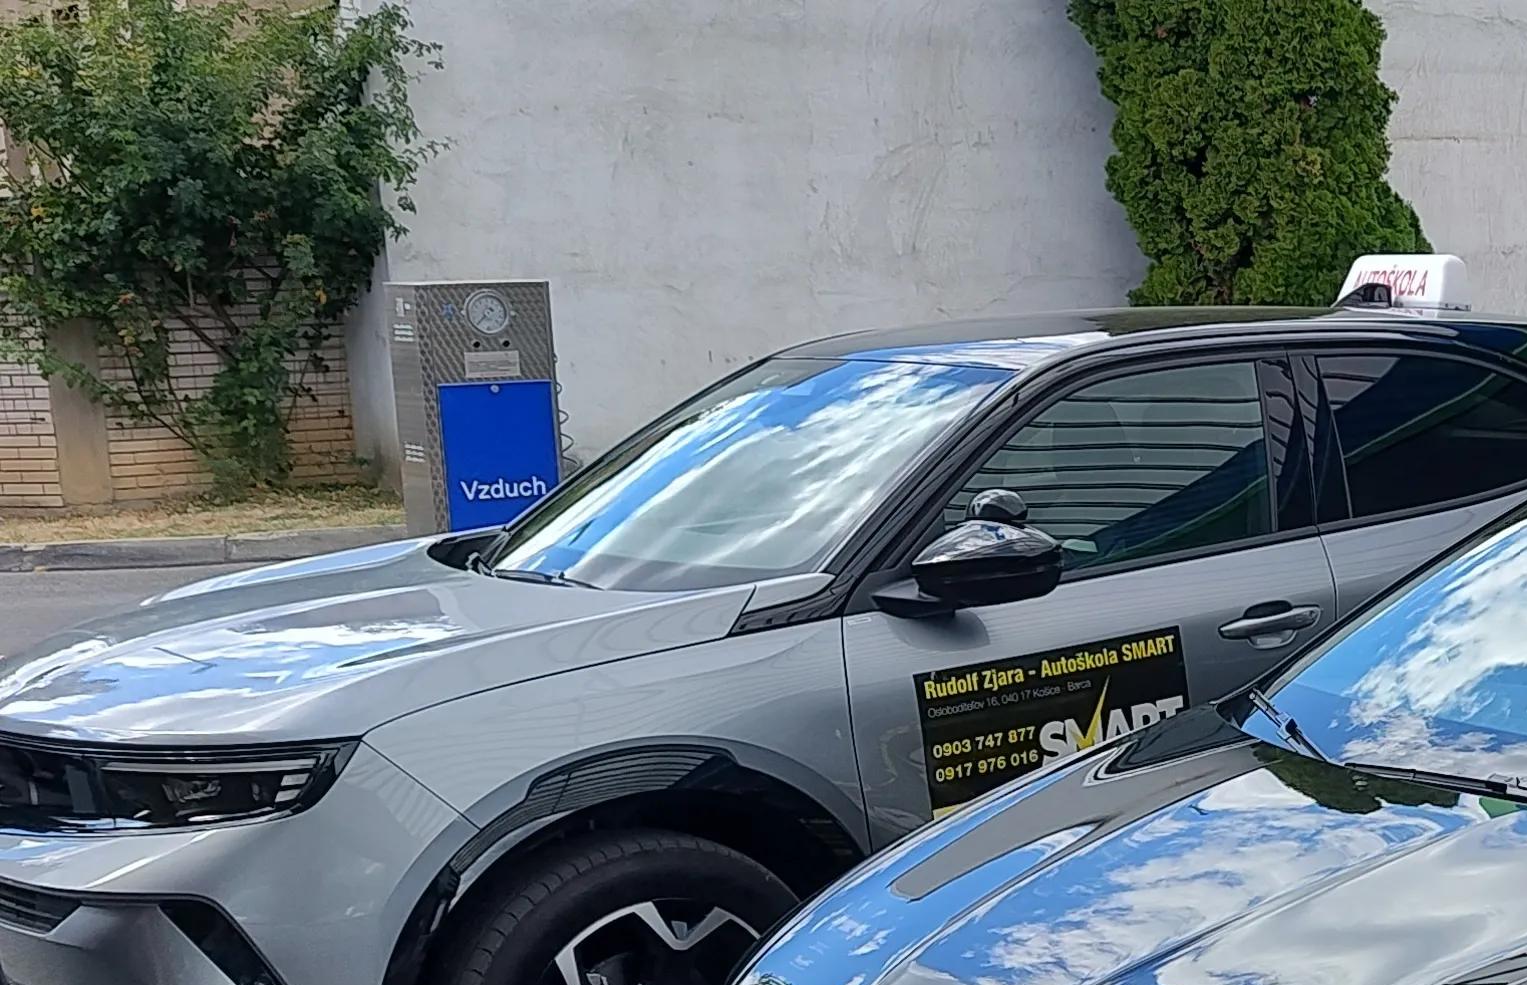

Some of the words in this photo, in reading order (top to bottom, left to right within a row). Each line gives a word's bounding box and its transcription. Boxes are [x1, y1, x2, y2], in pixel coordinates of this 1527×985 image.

[460, 476, 547, 501] Vzduch
[923, 672, 979, 700] Rudolf
[981, 667, 1025, 692] Zjara
[1040, 648, 1119, 679] Autoškola
[1121, 634, 1176, 663] SMART
[932, 741, 972, 760] 0903
[975, 733, 1003, 751] 747
[1007, 726, 1036, 743] 877
[935, 763, 972, 783] 0917
[977, 756, 1006, 774] 976
[1010, 749, 1039, 767] 016
